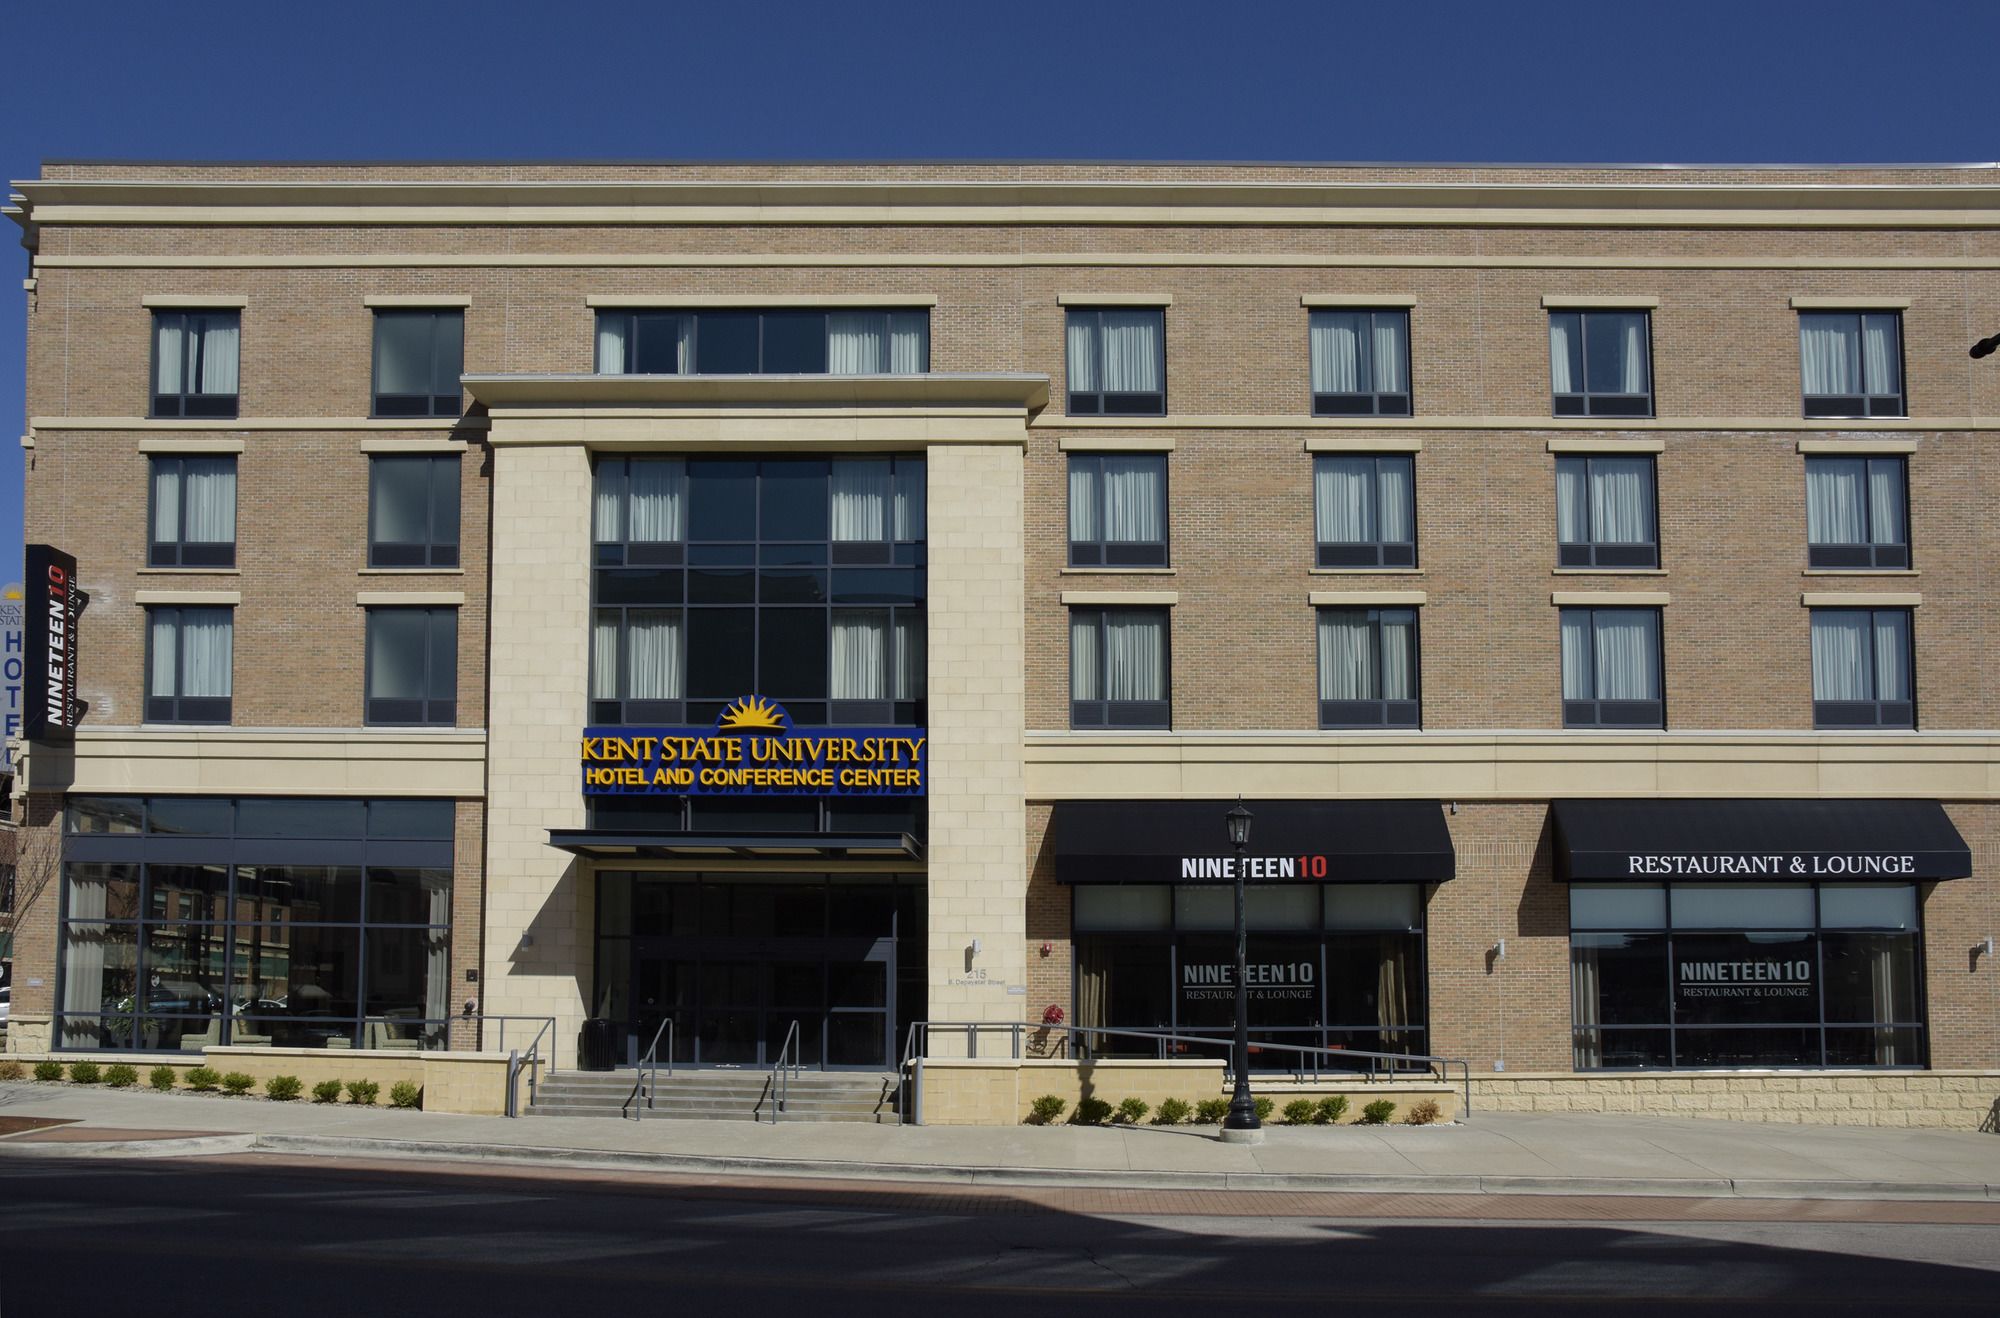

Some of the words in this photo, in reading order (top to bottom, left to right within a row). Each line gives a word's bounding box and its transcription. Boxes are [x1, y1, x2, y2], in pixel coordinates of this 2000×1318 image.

[0, 605, 23, 615] KEN
[0, 615, 23, 625] STAT
[48, 564, 65, 727] NINETEEN10
[68, 632, 75, 642] &
[66, 643, 75, 727] RESTAURANT
[581, 737, 658, 761] KENT
[661, 736, 743, 761] STATE
[750, 737, 926, 762] UNIVERSITY
[586, 768, 649, 785] HOTEL
[653, 768, 695, 785] AND
[700, 768, 834, 786] CONFERENCE
[840, 768, 921, 786] CENTER
[1628, 856, 1783, 874] RESTAURANT
[1789, 856, 1806, 874] &
[1813, 855, 1915, 873] LOUNGE
[966, 968, 987, 979] 215
[1183, 962, 1313, 983] NINEEEN10
[1680, 960, 1810, 981] NINETEEN10
[1186, 990, 1255, 1000] RESTAURT
[1256, 990, 1264, 999] &
[1267, 989, 1312, 999] LOUNGE
[1683, 988, 1752, 997] RESTAURANT
[1754, 988, 1762, 997] &
[1764, 987, 1809, 997] LOUNGE
